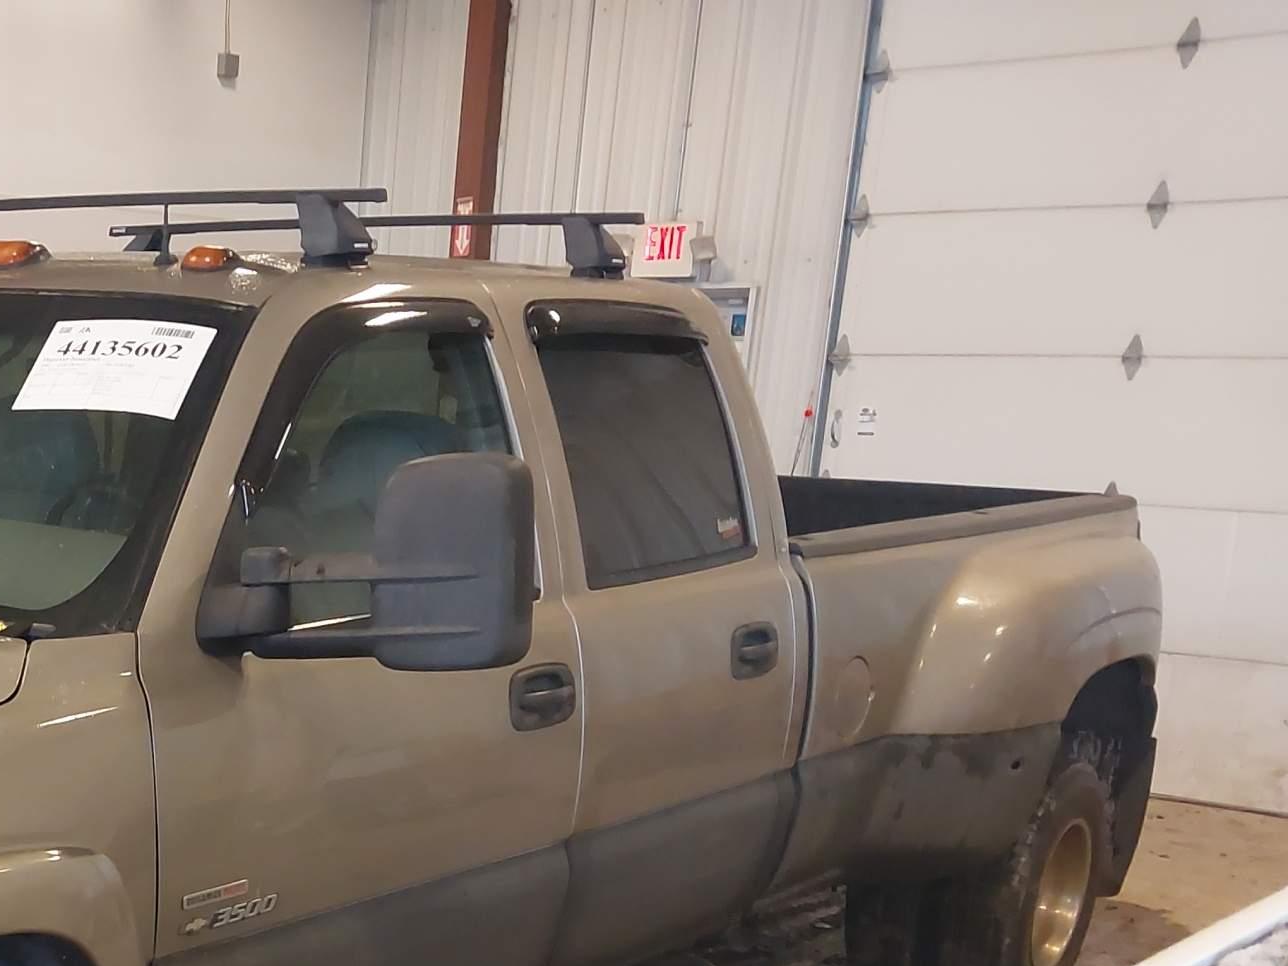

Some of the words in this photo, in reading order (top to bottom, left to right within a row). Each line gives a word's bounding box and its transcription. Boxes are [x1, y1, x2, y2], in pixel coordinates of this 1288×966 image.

[644, 225, 687, 261] EXIT
[57, 339, 183, 360] 44135602
[213, 893, 278, 928] 3500
